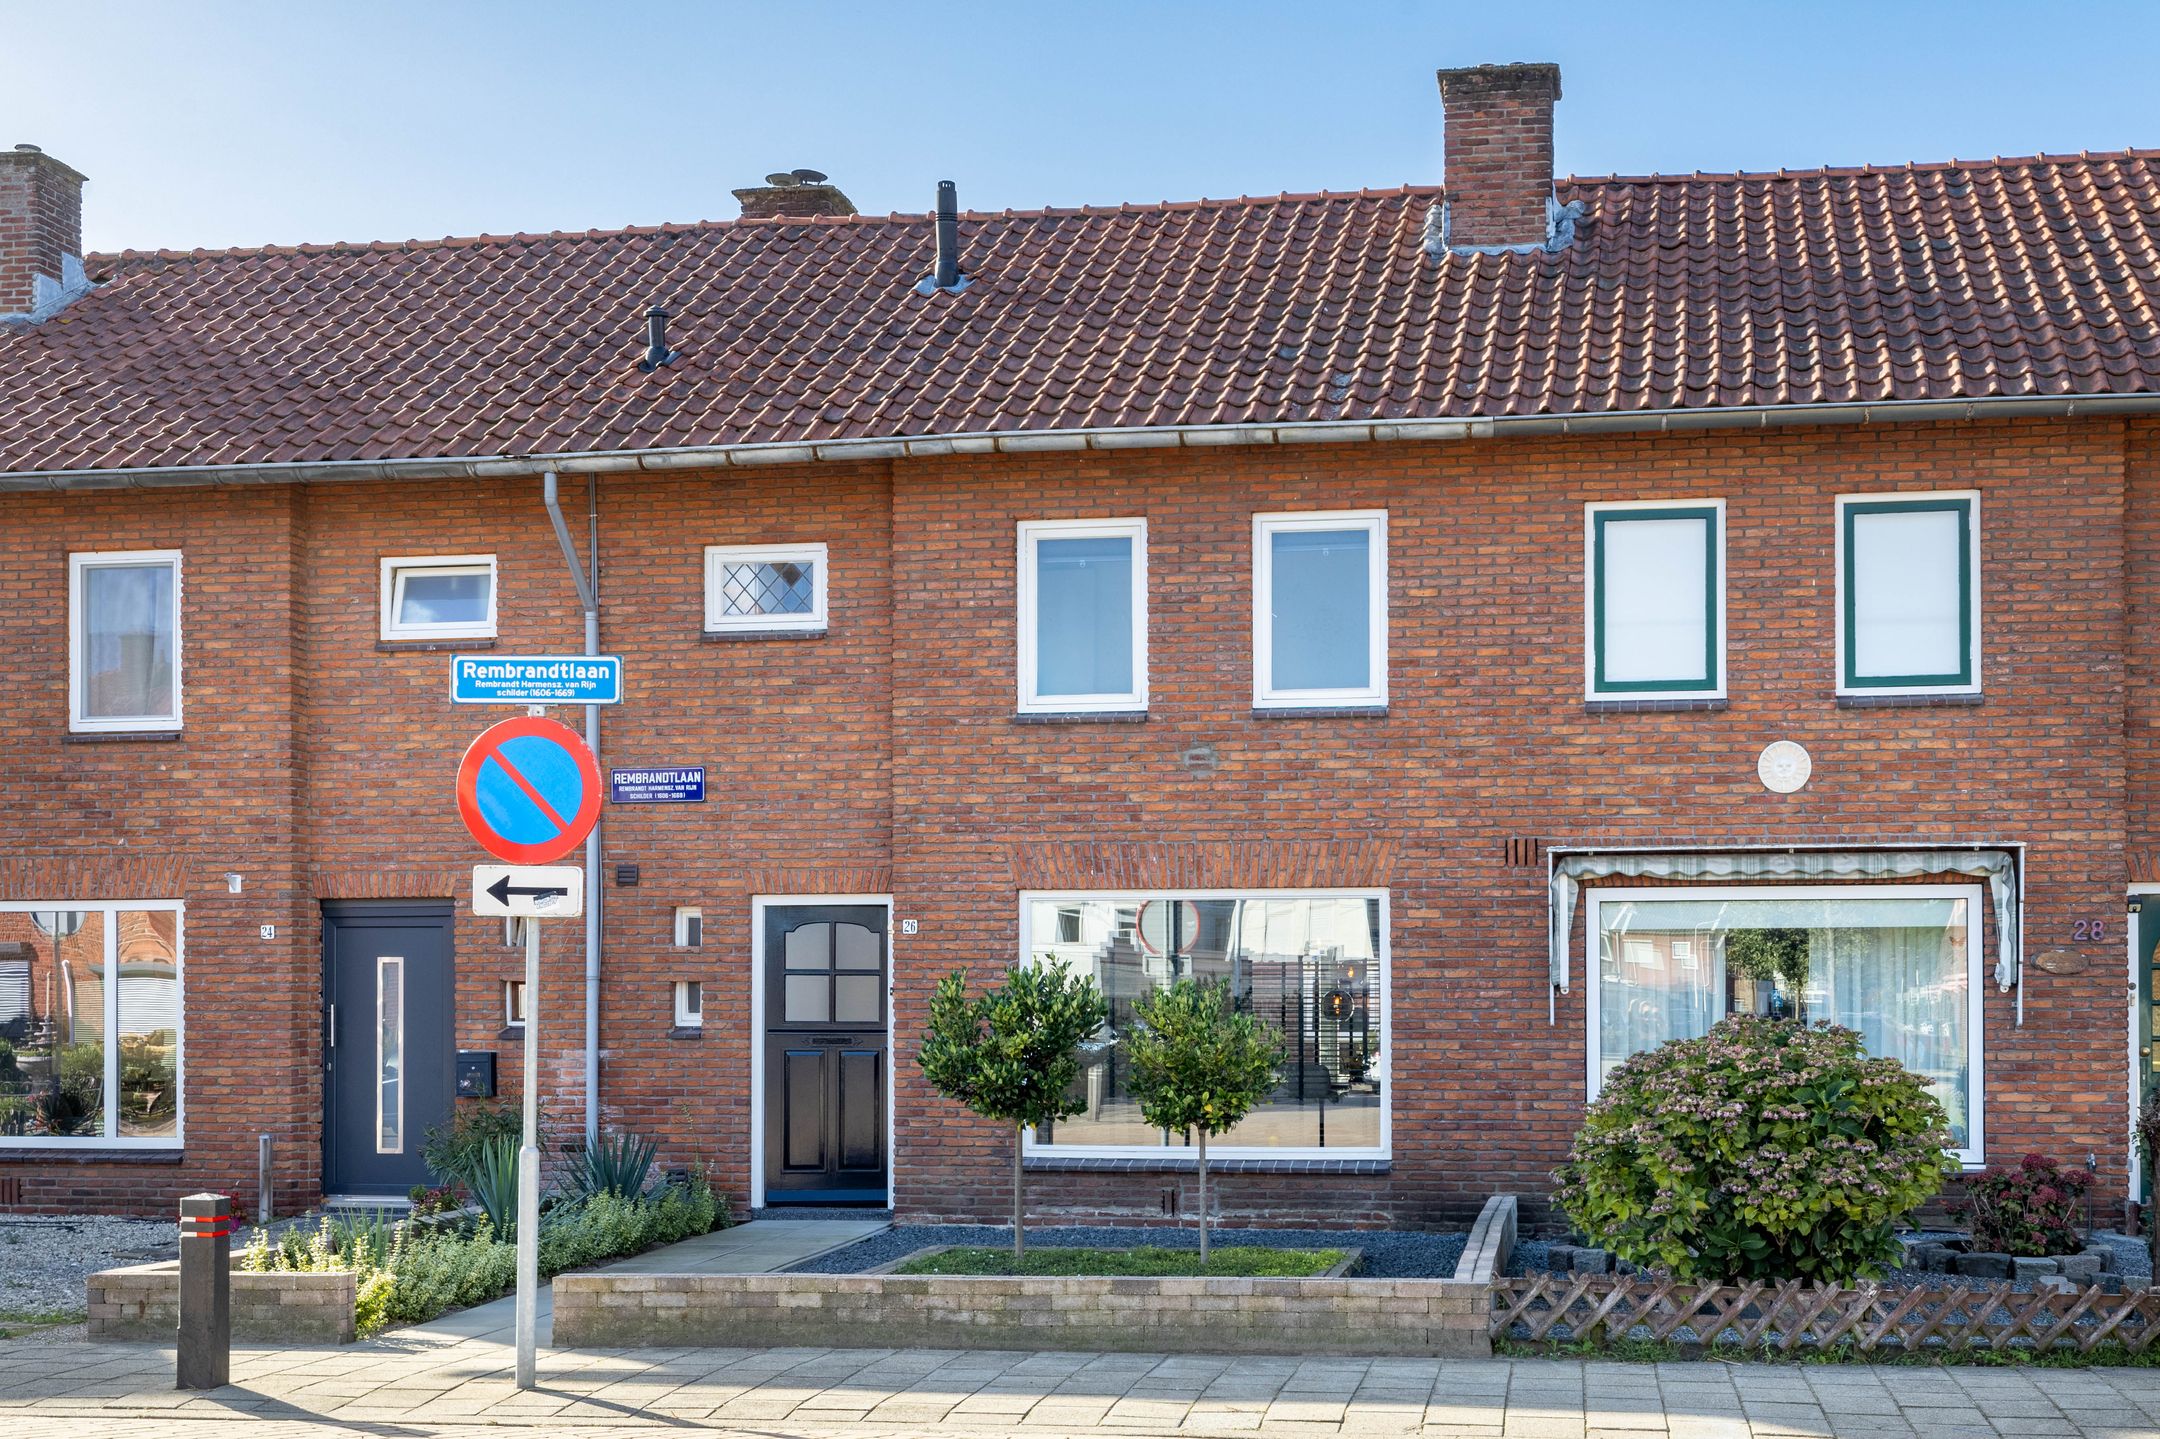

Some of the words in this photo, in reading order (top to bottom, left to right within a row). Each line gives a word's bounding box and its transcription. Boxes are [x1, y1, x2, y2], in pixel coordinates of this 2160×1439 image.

[463, 662, 610, 679] Rembrandtlaan
[475, 680, 520, 688] Rembrandt
[521, 680, 564, 688] Harmensz.
[581, 680, 597, 690] Rijn
[496, 689, 528, 697] schilder
[530, 689, 575, 697] (1606-1669)
[614, 771, 701, 784] REMBRANDTLAAN
[261, 926, 273, 938] 24
[904, 920, 916, 933] 26
[2073, 919, 2105, 941] 28
